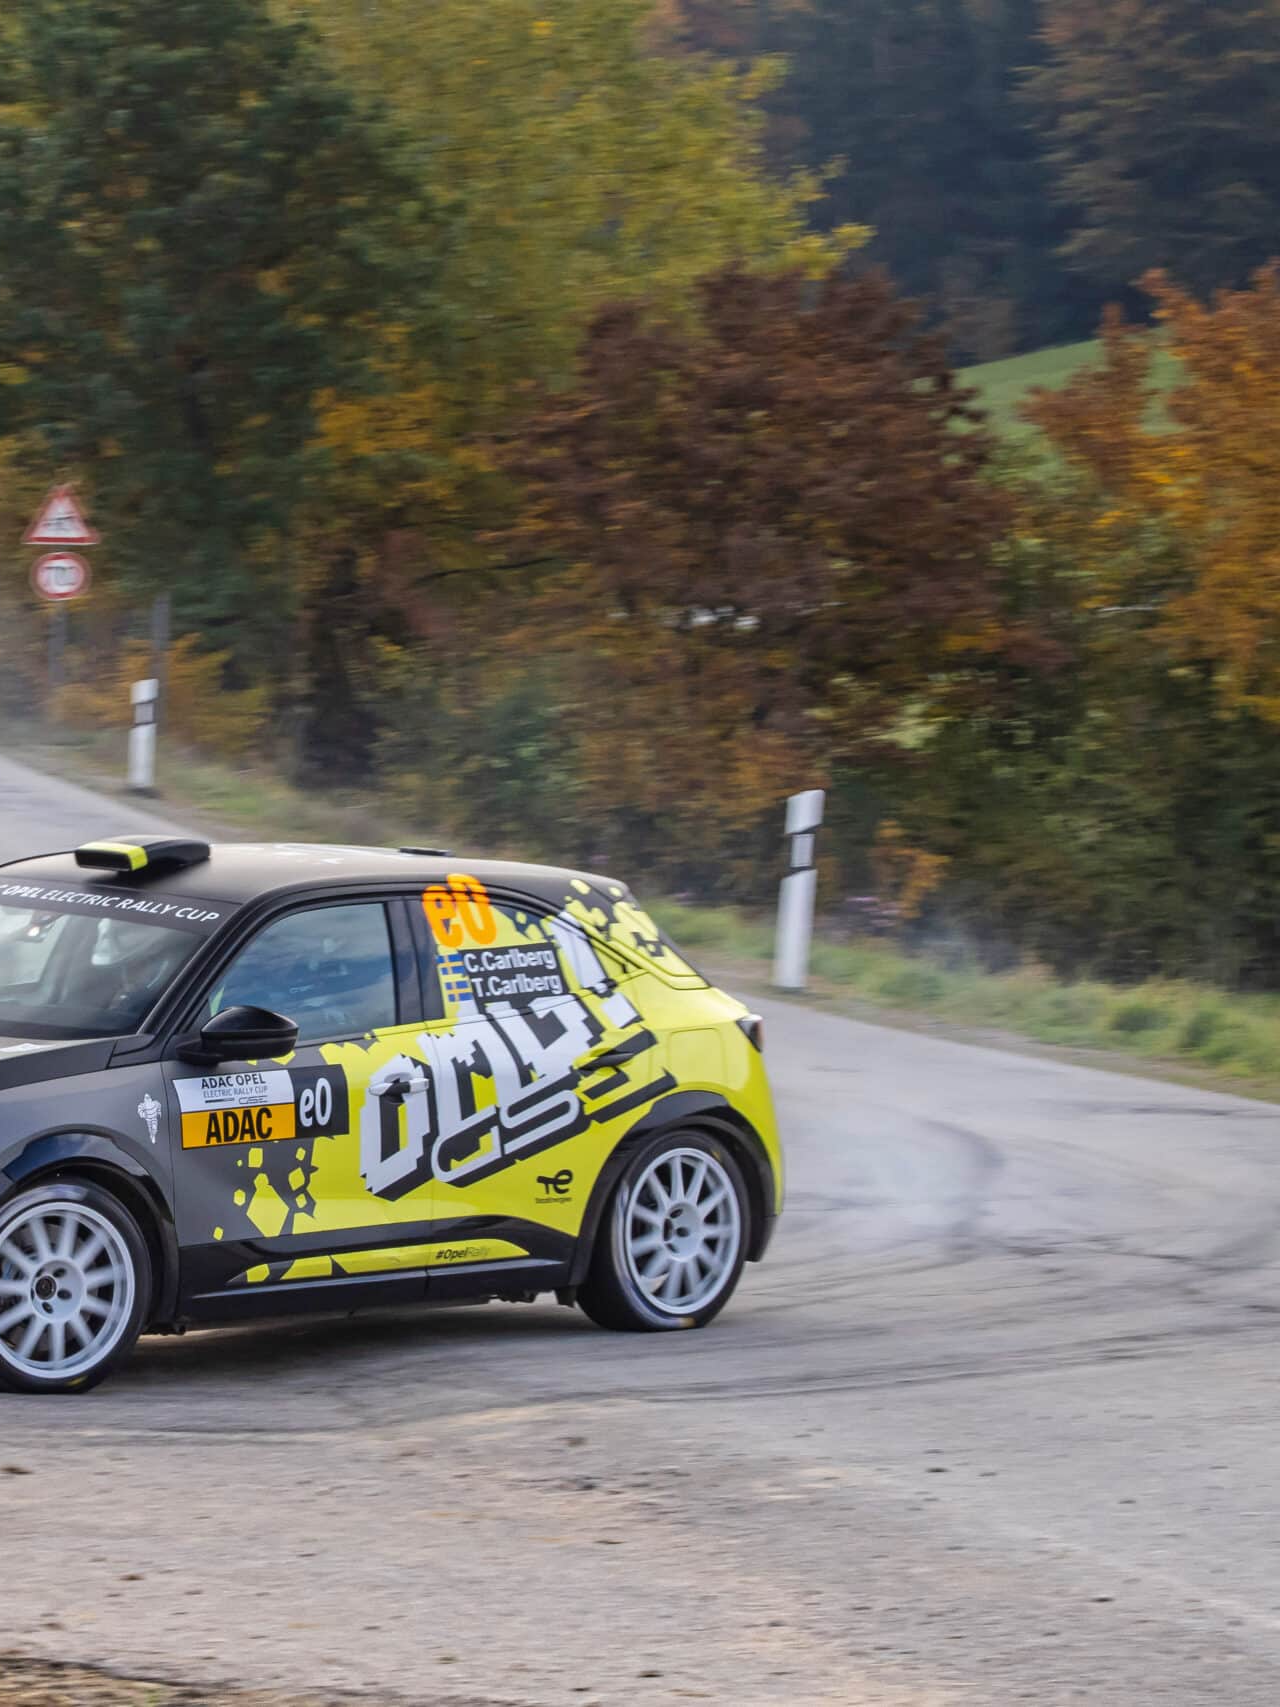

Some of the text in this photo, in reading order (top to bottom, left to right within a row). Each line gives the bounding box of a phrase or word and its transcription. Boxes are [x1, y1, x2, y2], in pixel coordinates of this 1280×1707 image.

[3, 885, 44, 900] OPEL
[40, 889, 118, 908] ELECTRIC
[115, 898, 175, 915] RALLY
[175, 906, 220, 924] CUP
[463, 949, 556, 974] C.Carlberg
[470, 974, 563, 998] T.Carlberg
[201, 1072, 267, 1090] ADAC OPEL
[203, 1085, 268, 1099] ELECTRIC RALLY CUP
[206, 1107, 273, 1145] ADAC
